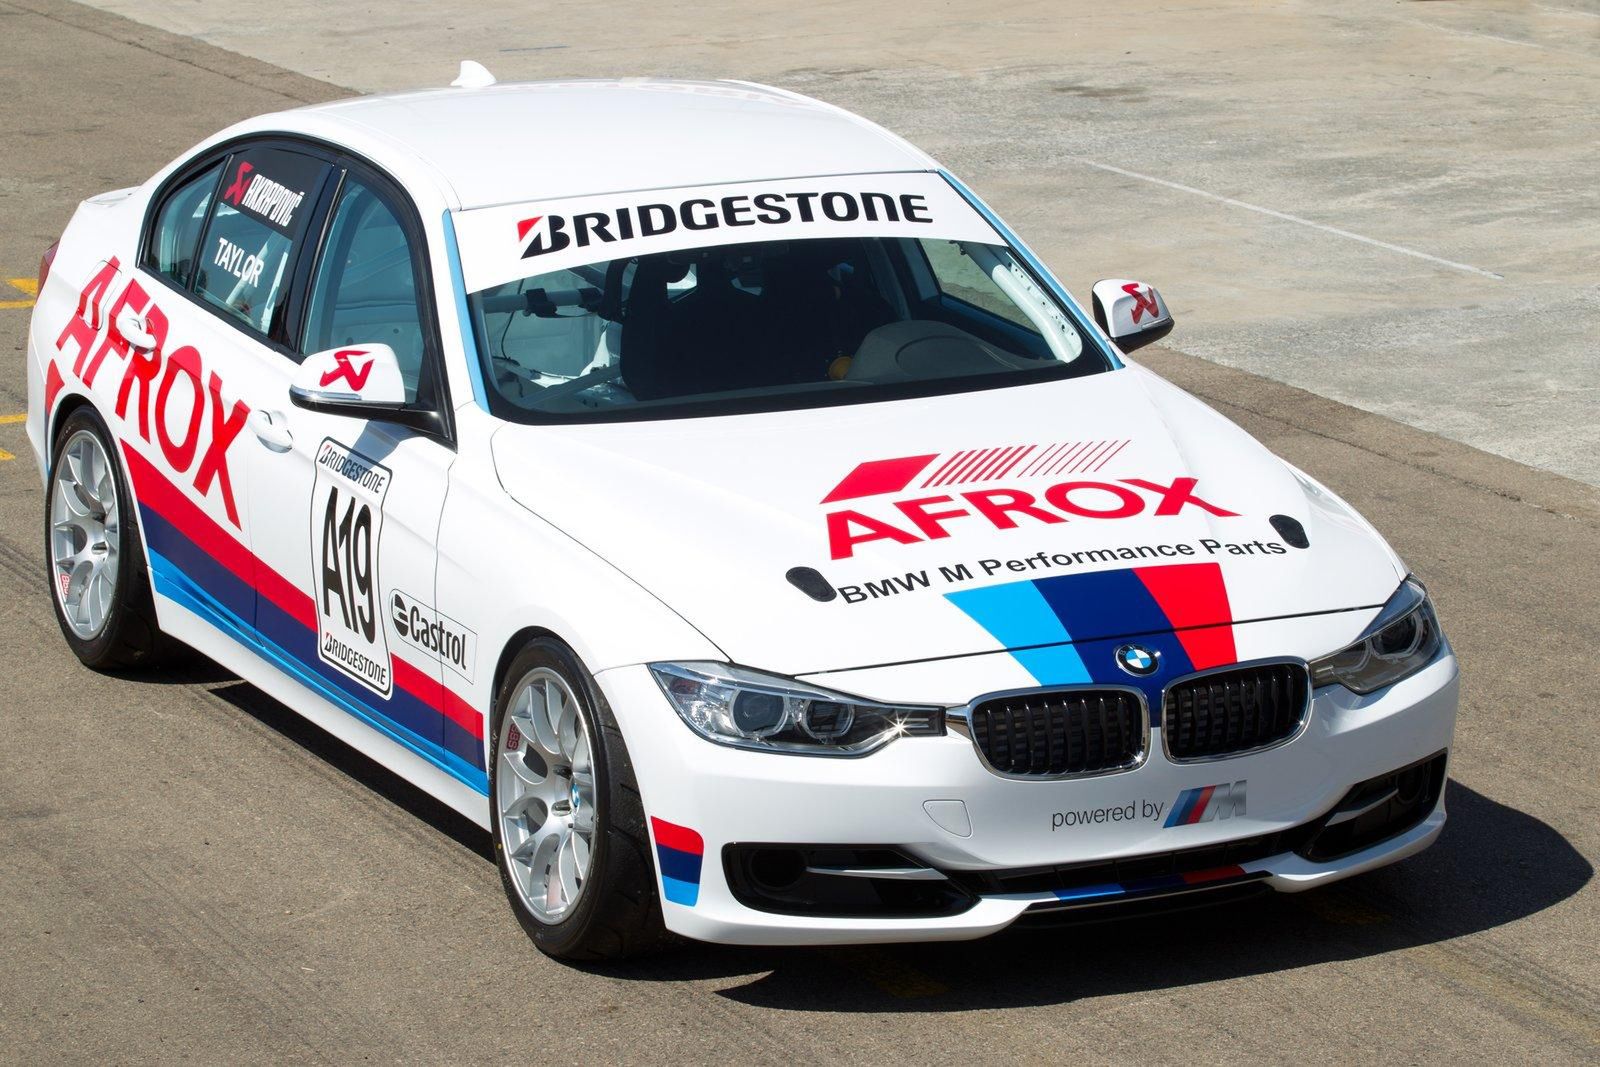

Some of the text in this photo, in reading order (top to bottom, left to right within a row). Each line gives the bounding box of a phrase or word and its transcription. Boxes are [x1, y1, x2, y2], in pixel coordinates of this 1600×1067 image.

[516, 191, 934, 260] BRIDGESTONE
[214, 237, 265, 288] TAYLOR
[55, 255, 251, 532] AFROX
[318, 444, 386, 494] BRIDGESTONE
[826, 476, 1243, 561] AFROX
[322, 485, 376, 645] A19
[837, 538, 1288, 605] BMW M Performance Parts
[324, 631, 387, 686] BRIDGESTONE
[409, 605, 467, 671] Castrol
[1052, 800, 1136, 832] powered
[1142, 799, 1165, 822] by
